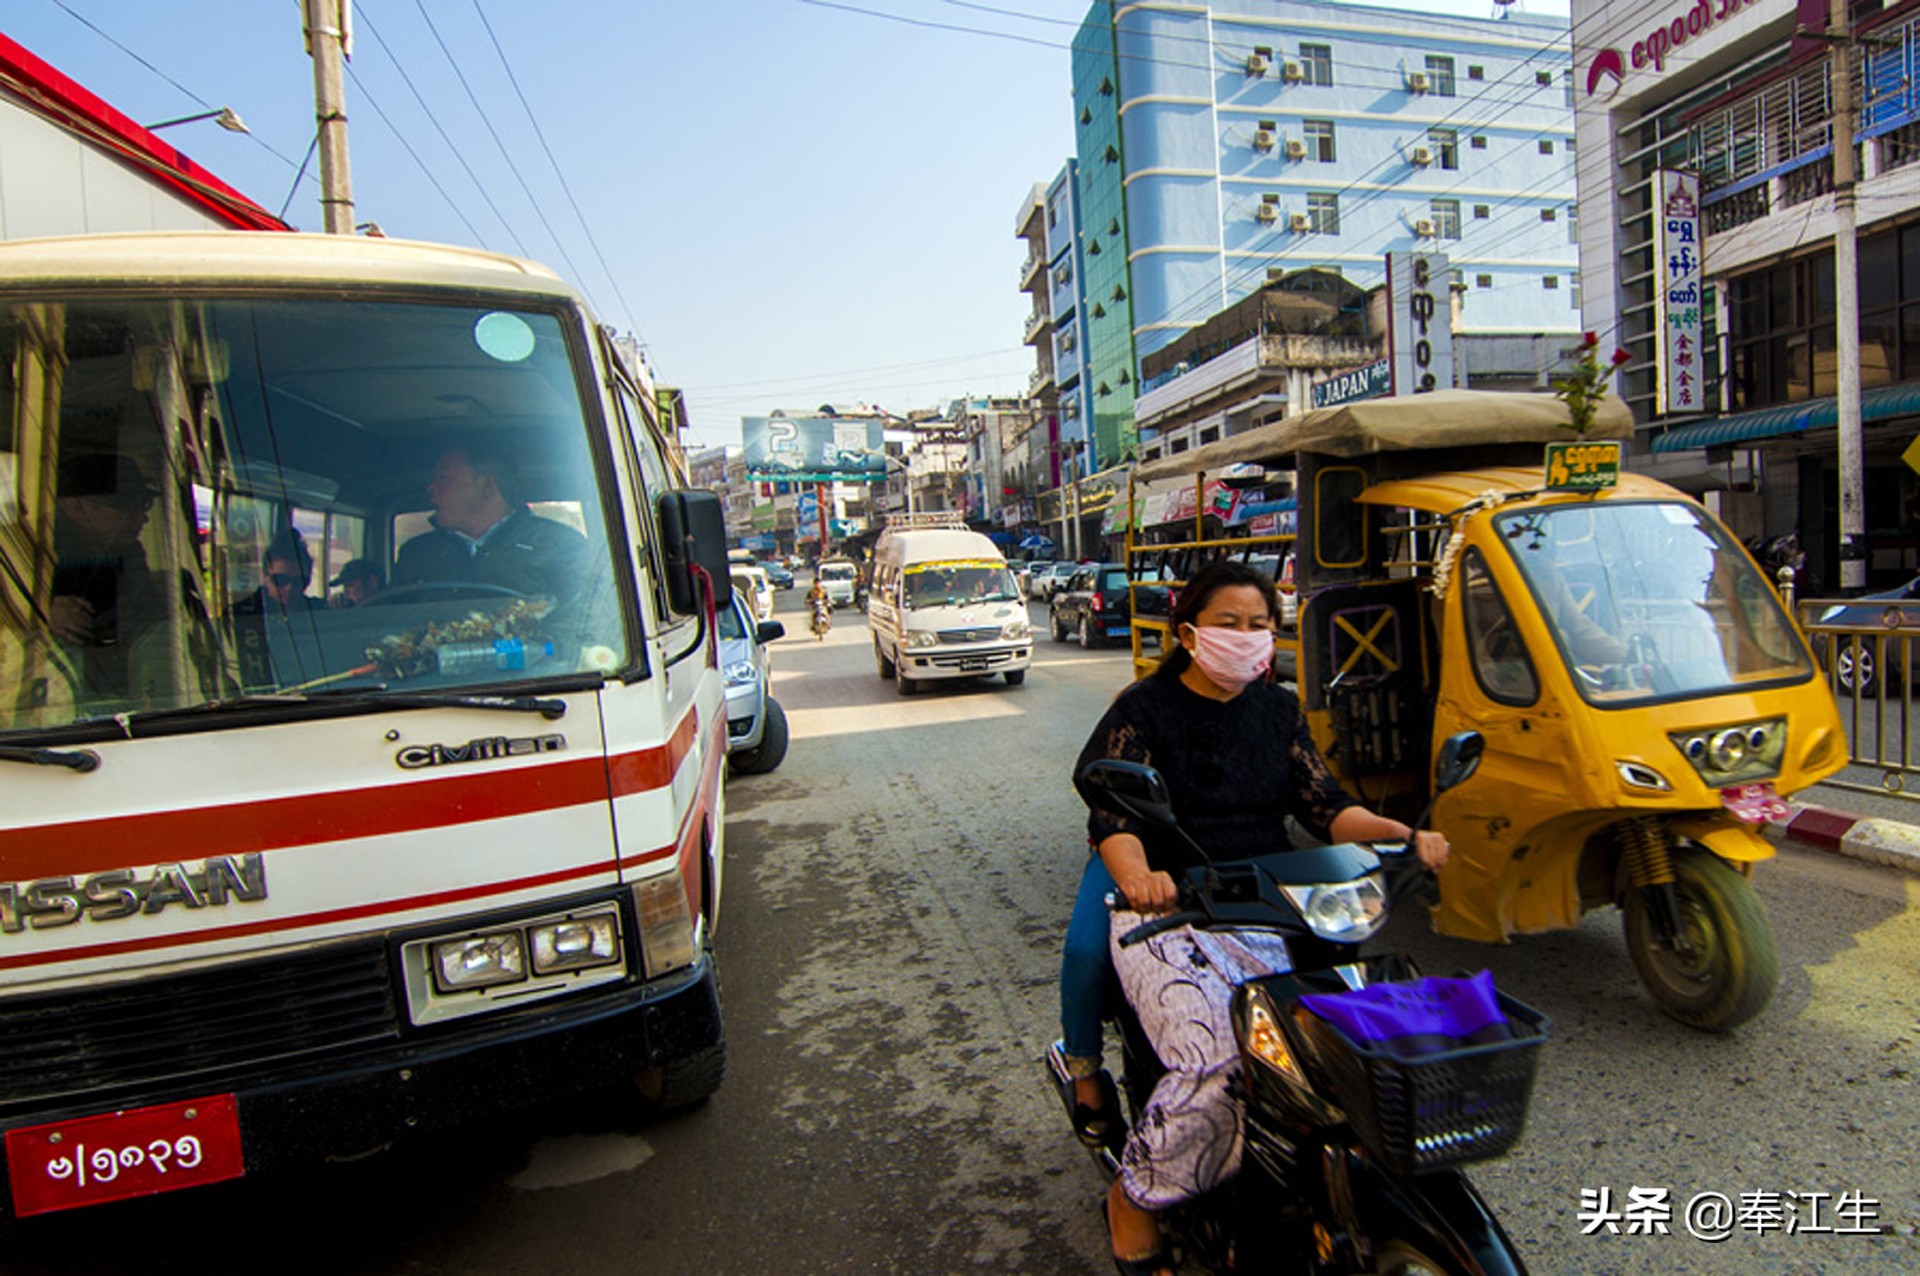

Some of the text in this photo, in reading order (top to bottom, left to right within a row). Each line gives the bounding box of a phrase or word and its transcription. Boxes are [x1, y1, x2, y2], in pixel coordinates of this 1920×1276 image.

[1324, 368, 1370, 405] JAPAN
[1673, 333, 1695, 406] 金都金店
